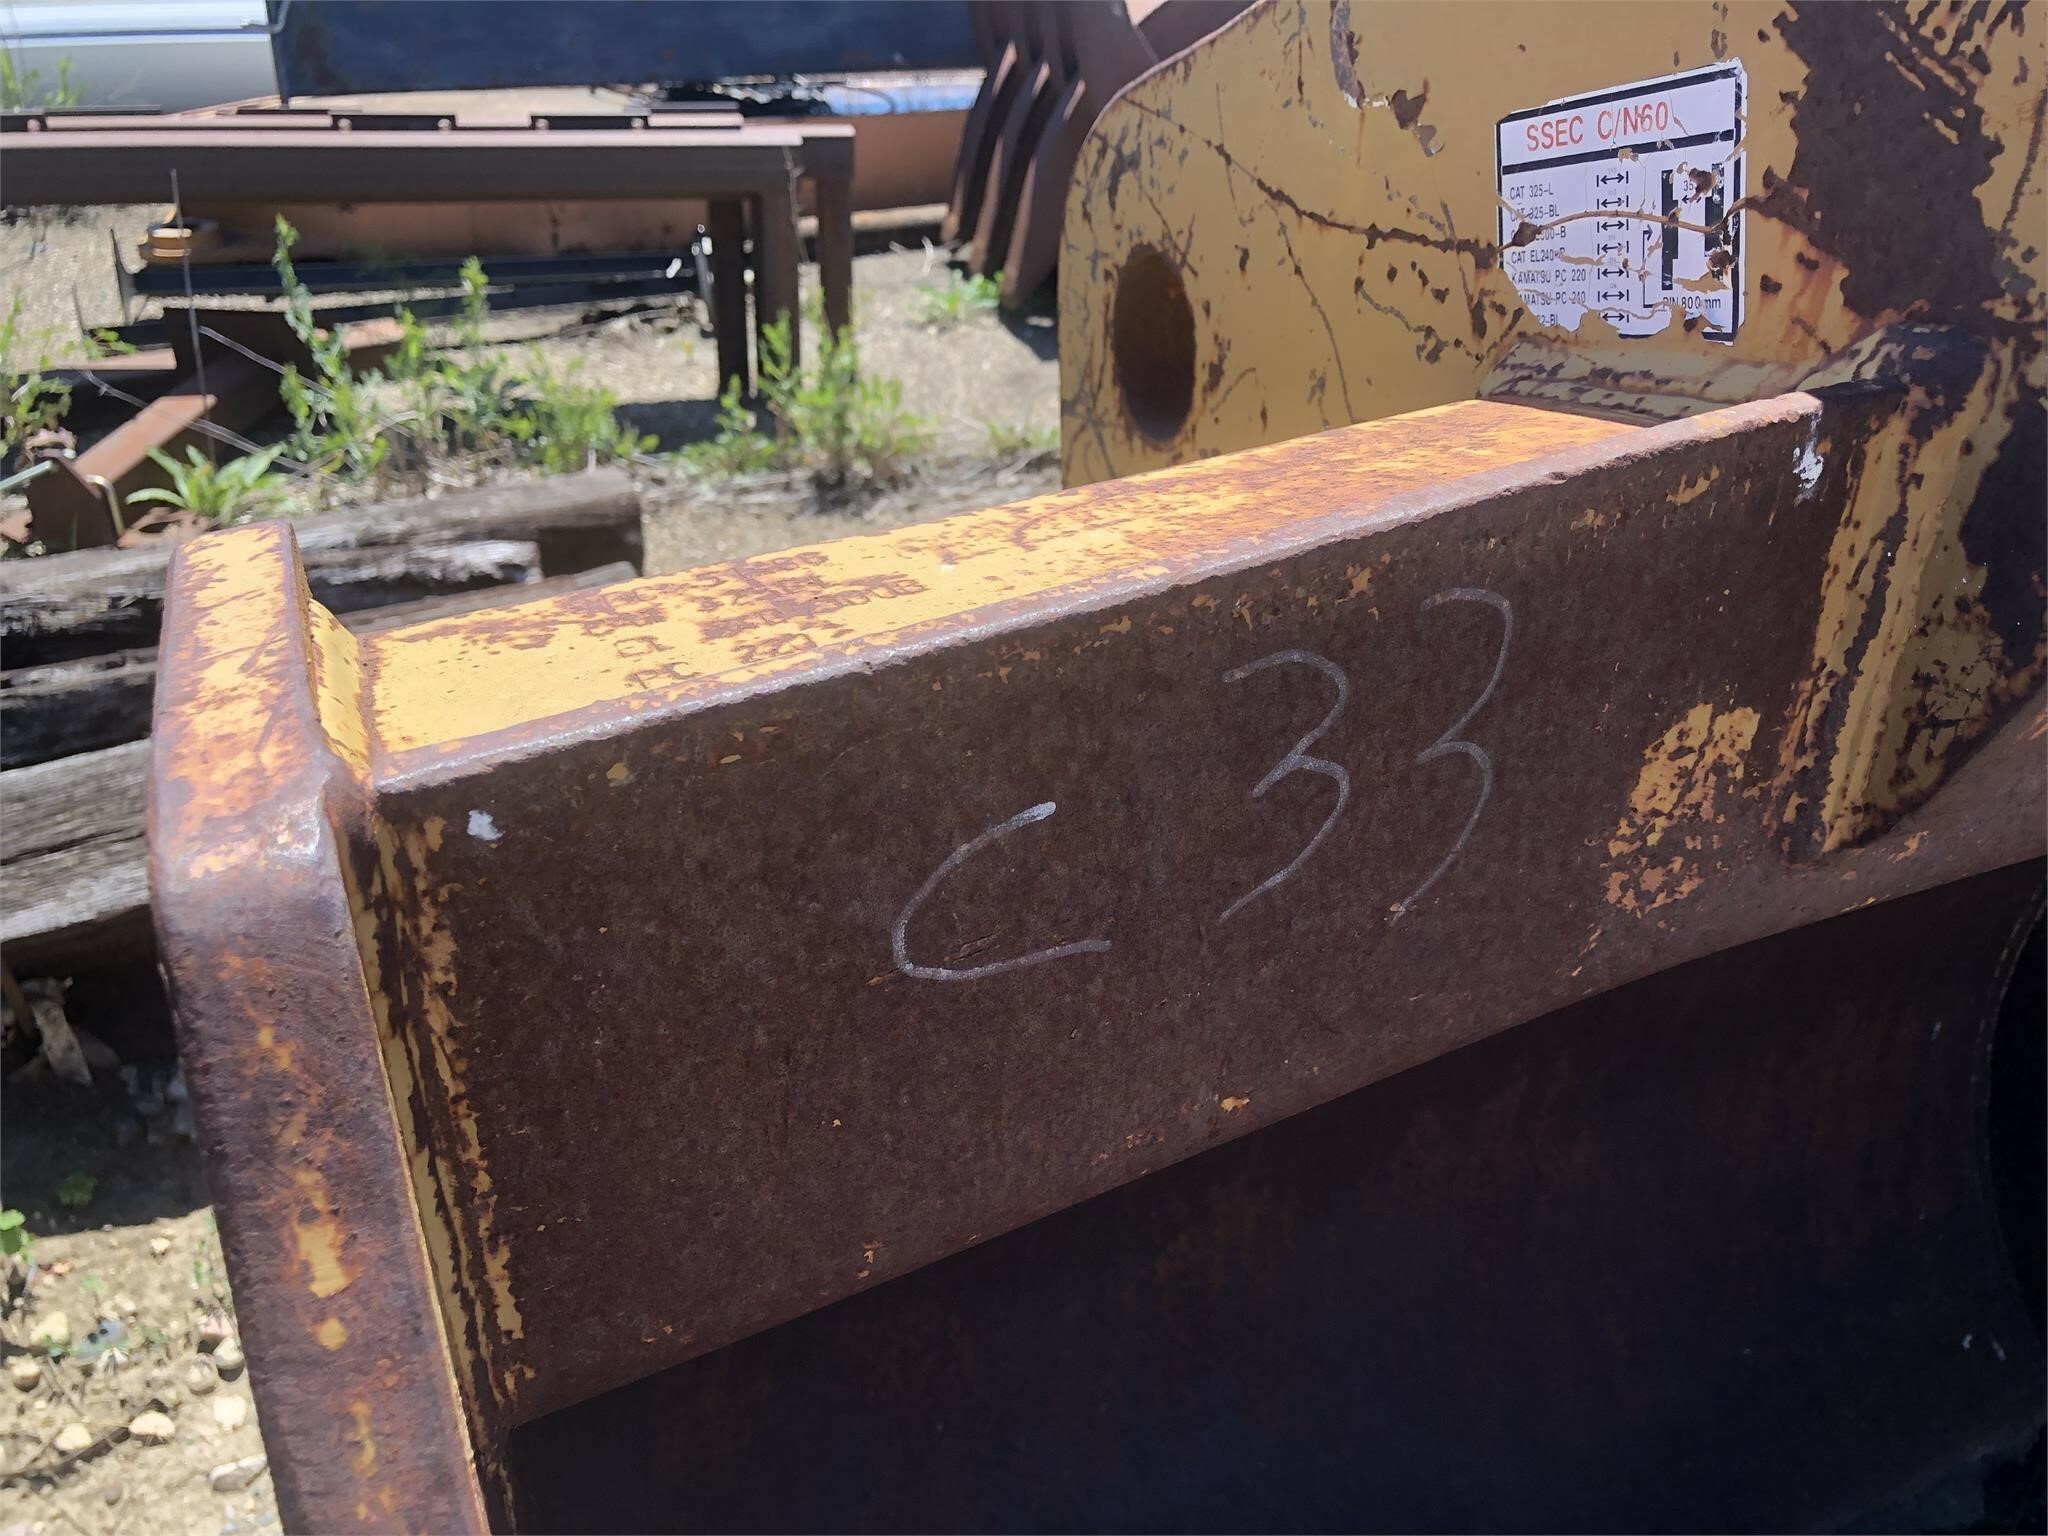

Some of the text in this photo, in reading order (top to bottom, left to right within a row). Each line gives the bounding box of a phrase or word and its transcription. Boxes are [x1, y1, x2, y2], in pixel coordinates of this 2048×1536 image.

[1526, 115, 1584, 153] SSEC
[1509, 182, 1554, 201] CAT 325-L
[1528, 204, 1560, 220] 325-BL
[1511, 250, 1526, 264] CAT
[1555, 269, 1567, 282] PC
[1571, 268, 1586, 282] 220
[1555, 291, 1567, 305] PC
